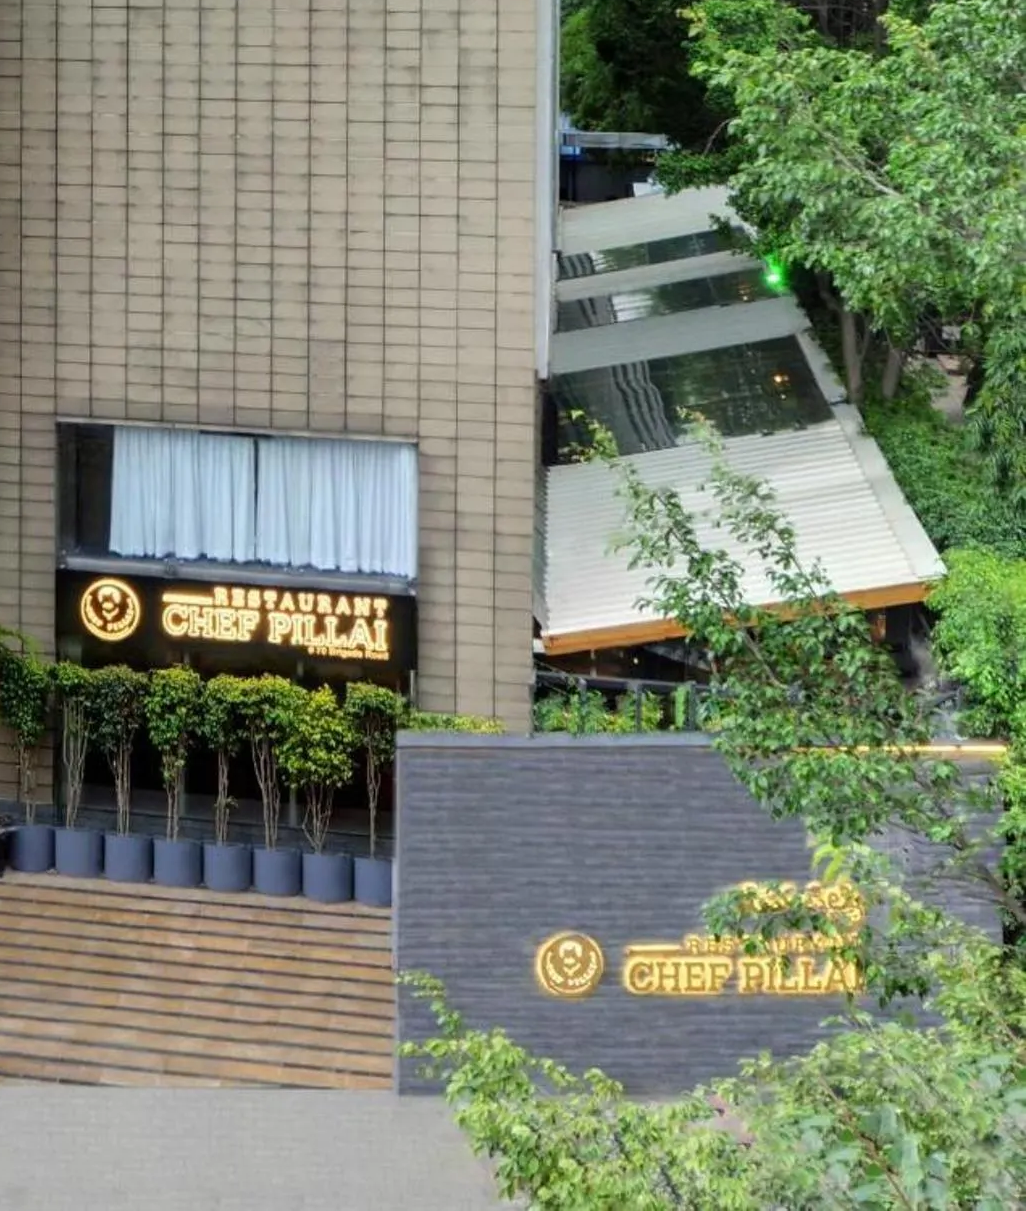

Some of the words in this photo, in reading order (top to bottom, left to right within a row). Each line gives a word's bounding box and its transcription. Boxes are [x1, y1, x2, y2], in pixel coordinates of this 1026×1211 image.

[213, 586, 389, 618] RESTAURANT
[161, 603, 260, 642] CHEF
[267, 611, 388, 652] PILLAI
[626, 957, 732, 993] CHEF
